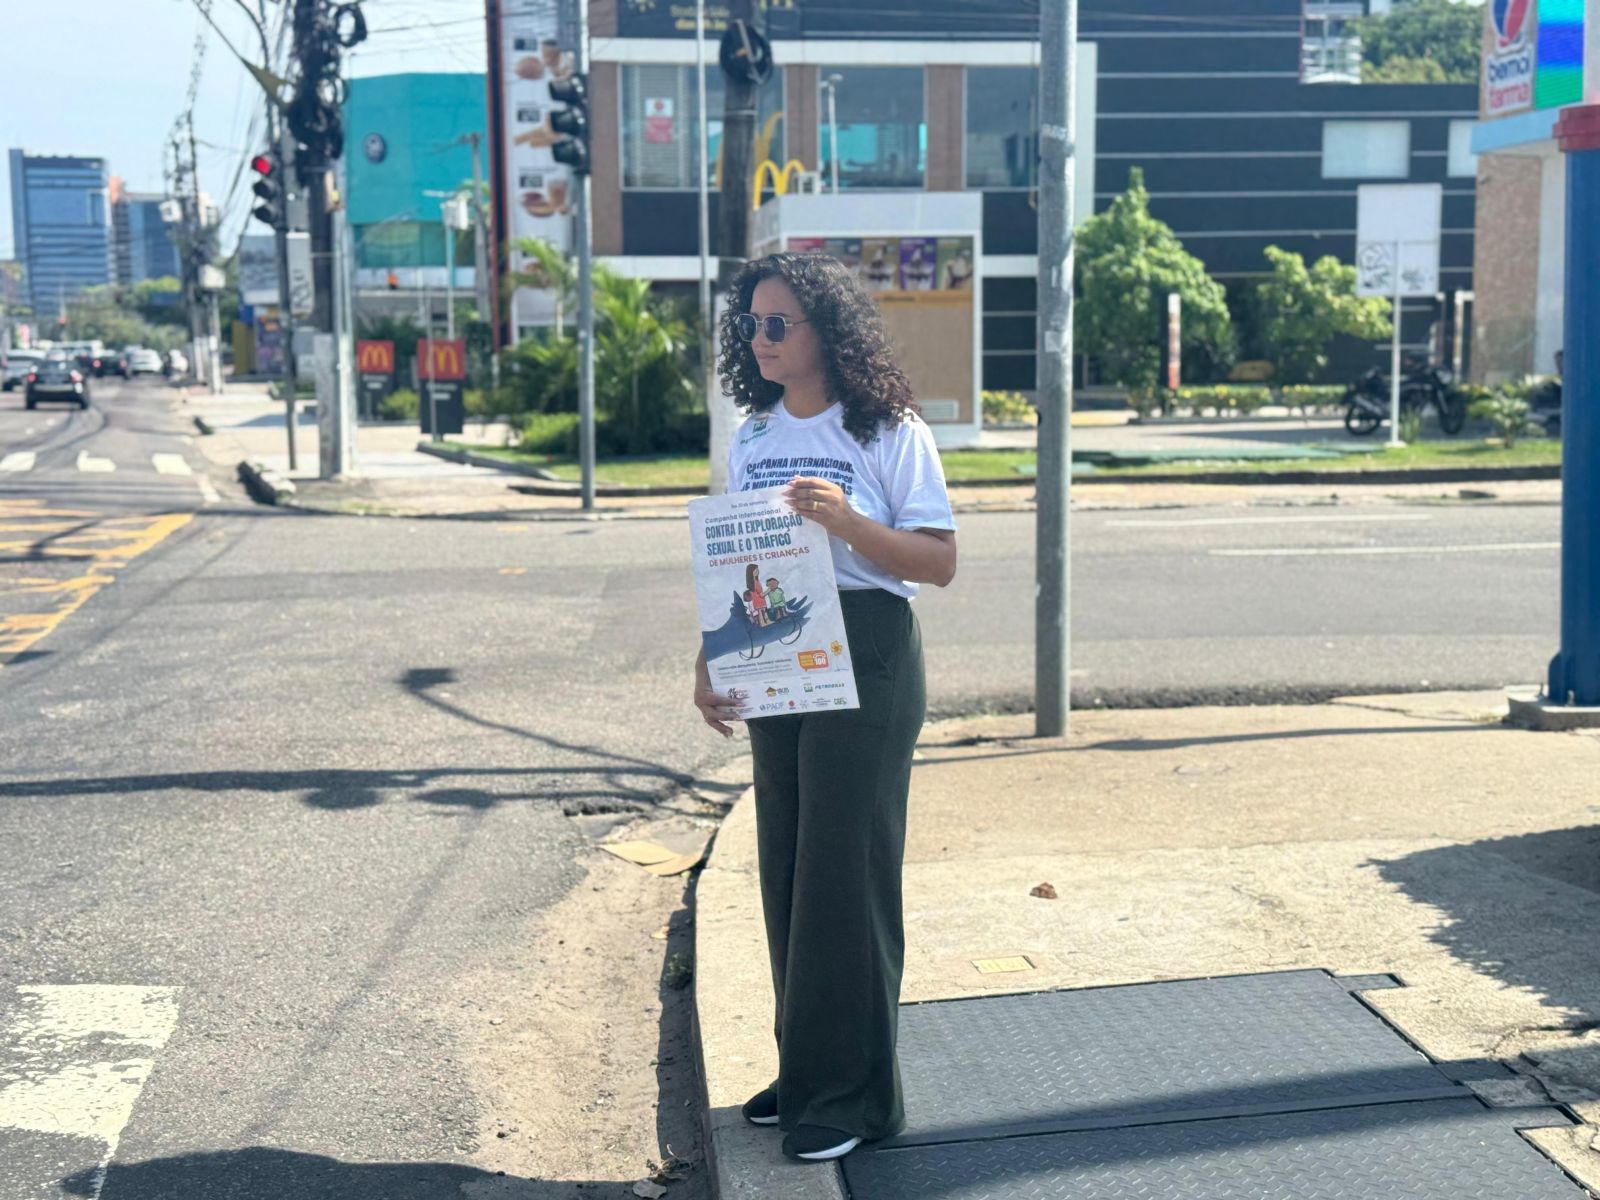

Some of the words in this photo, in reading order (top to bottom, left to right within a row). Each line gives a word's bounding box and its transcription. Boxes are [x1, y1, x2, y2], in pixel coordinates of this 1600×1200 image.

[705, 514, 738, 523] Campanha
[705, 521, 736, 539] CONTRA
[737, 521, 744, 535] A
[745, 512, 803, 532] EXPLORAÇÃO
[706, 541, 737, 556] SEXUAL
[738, 538, 744, 552] E
[745, 537, 752, 551] O
[754, 533, 792, 549] TRÁFICO
[709, 558, 718, 567] DE
[719, 554, 758, 565] MULHERES
[764, 546, 810, 558] CRIANÇAS
